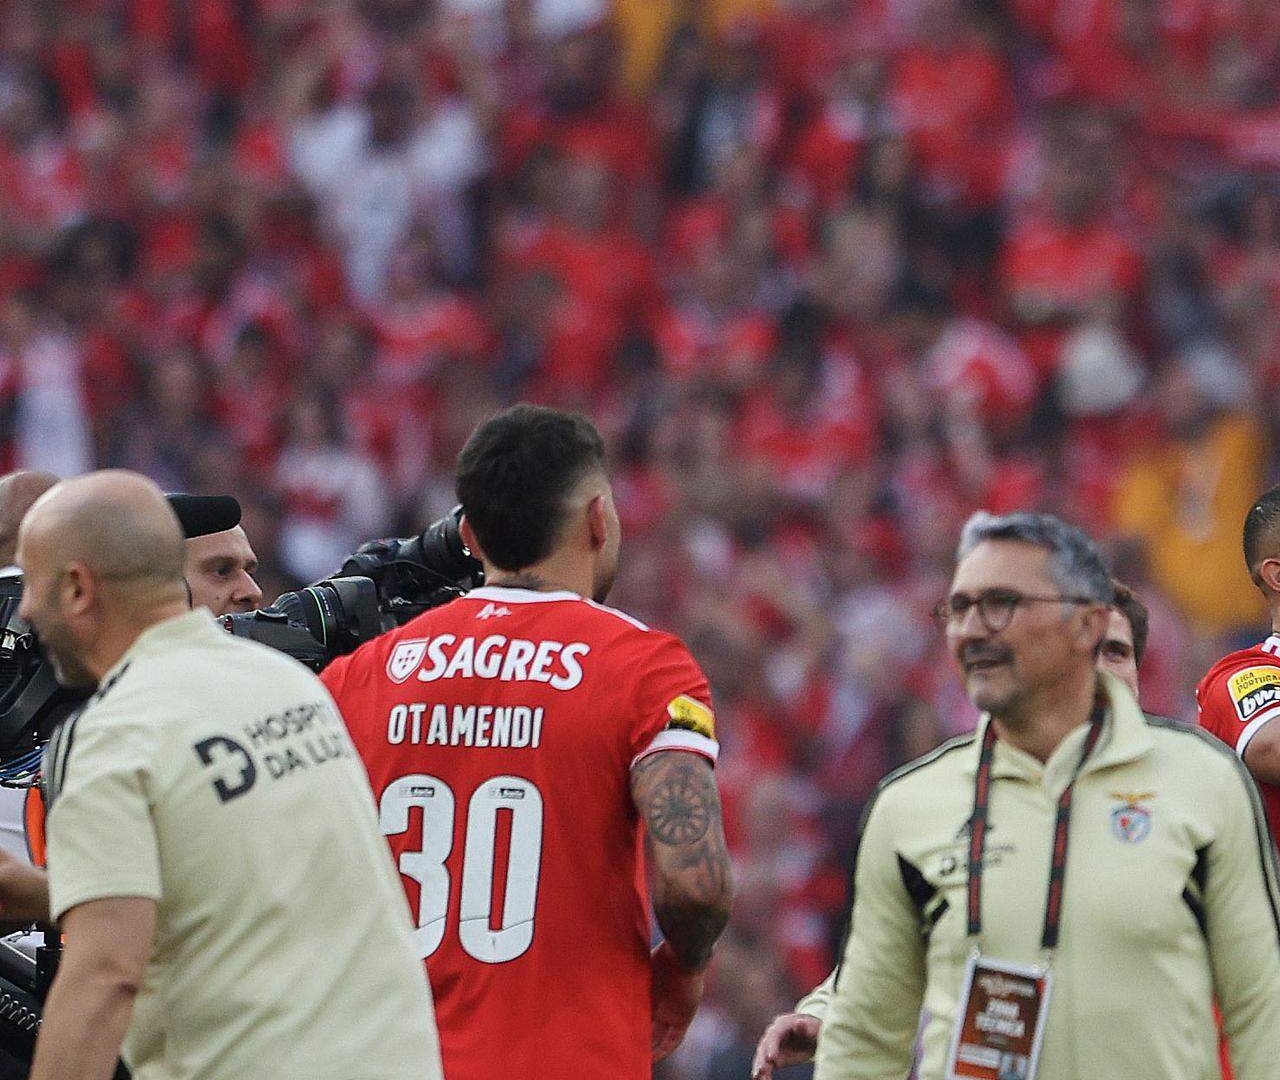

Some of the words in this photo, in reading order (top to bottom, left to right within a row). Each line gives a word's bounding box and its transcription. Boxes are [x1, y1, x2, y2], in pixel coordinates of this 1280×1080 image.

[417, 634, 591, 691] SAGRES
[387, 703, 544, 749] OTAMENDI
[379, 774, 544, 964] 30
